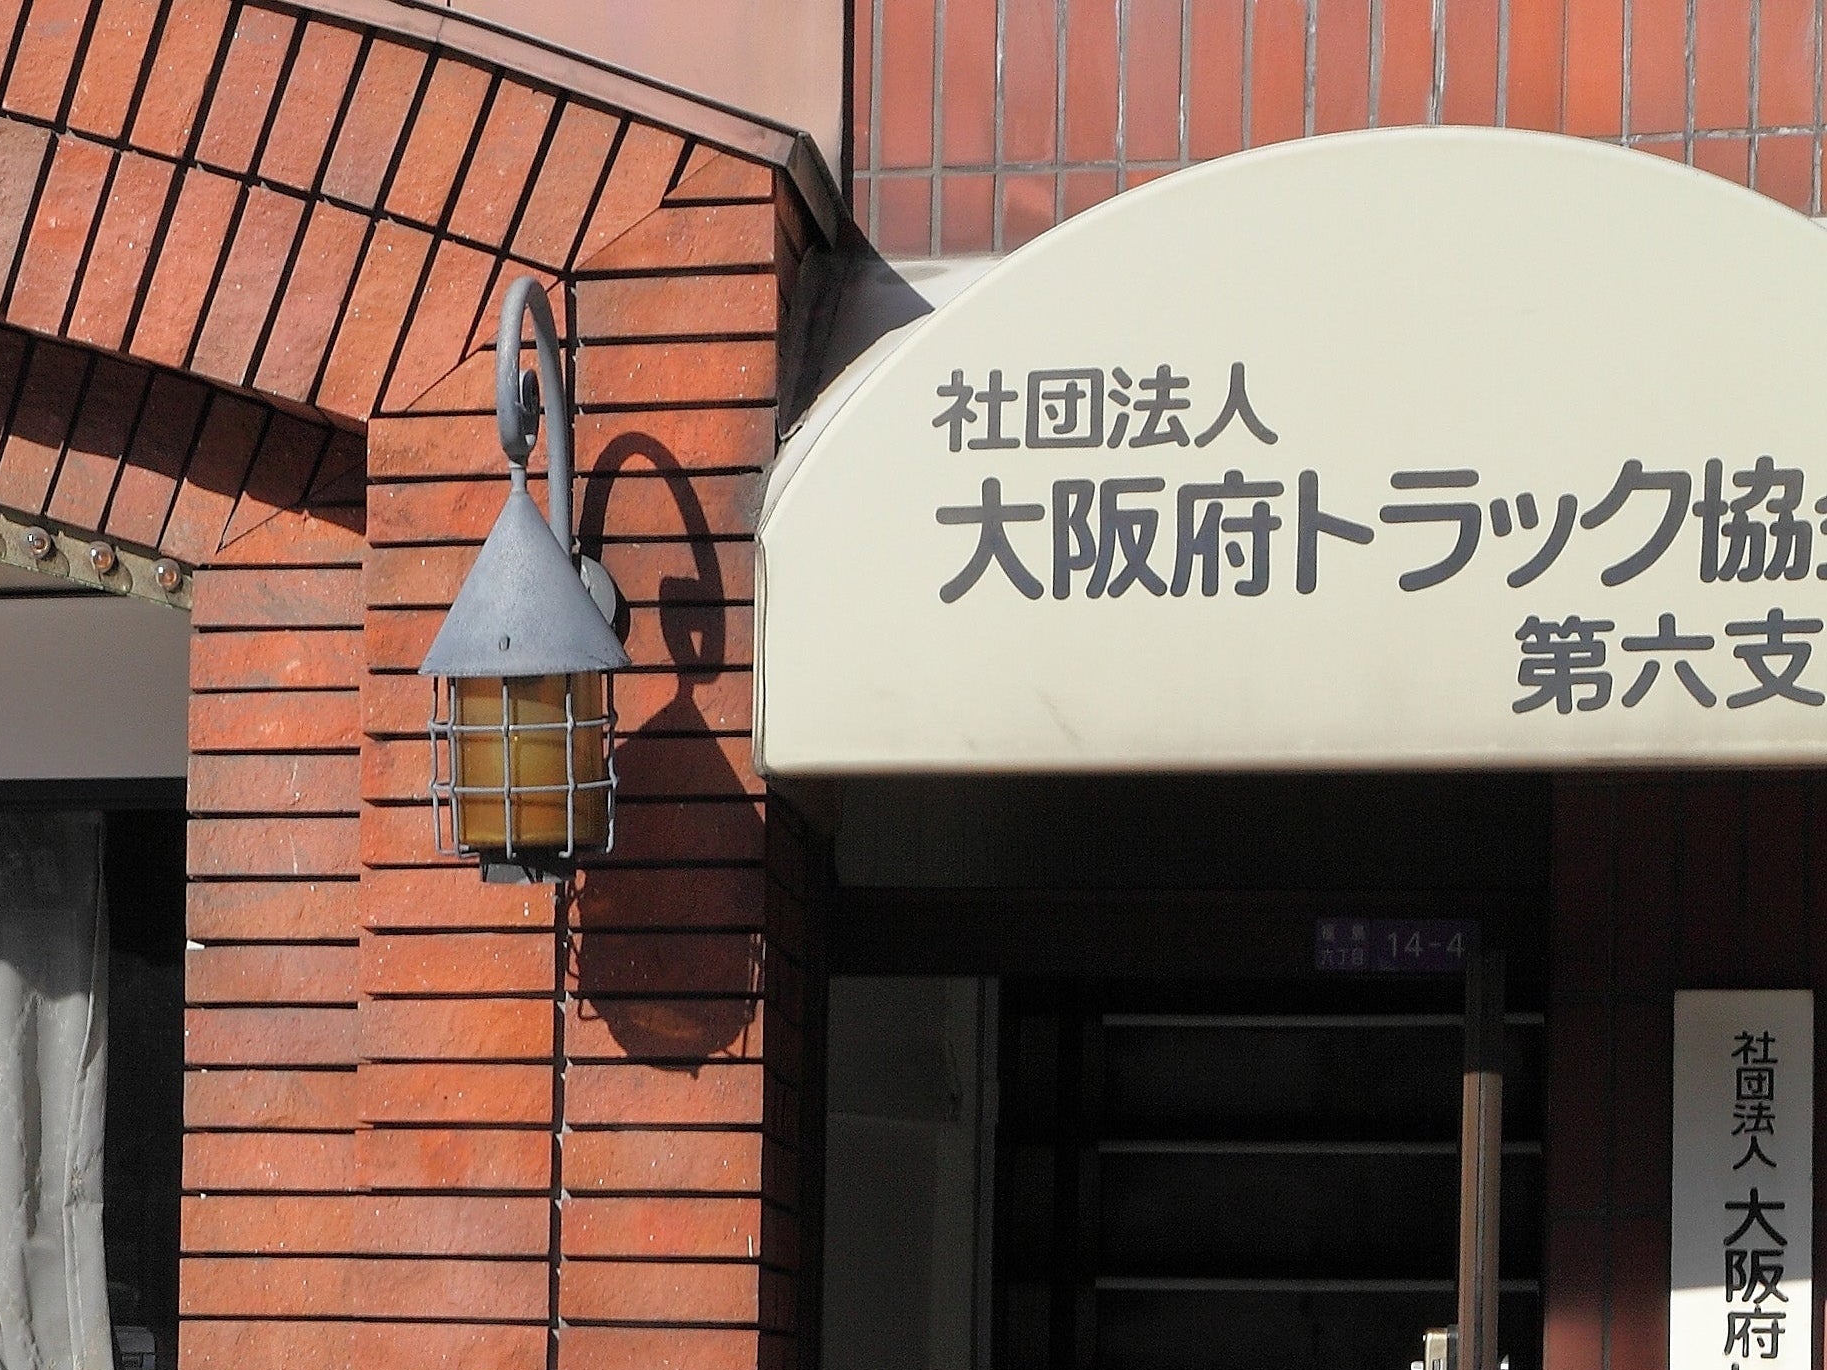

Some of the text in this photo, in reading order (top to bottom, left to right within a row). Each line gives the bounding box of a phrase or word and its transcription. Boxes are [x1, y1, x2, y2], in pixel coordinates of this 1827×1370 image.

[931, 361, 1279, 453] 社団法人
[934, 454, 1827, 604] 大阪府トラック協
[1510, 607, 1826, 715] 第六支
[1386, 930, 1466, 959] 14-4
[1730, 1030, 1779, 1171] 社団法人
